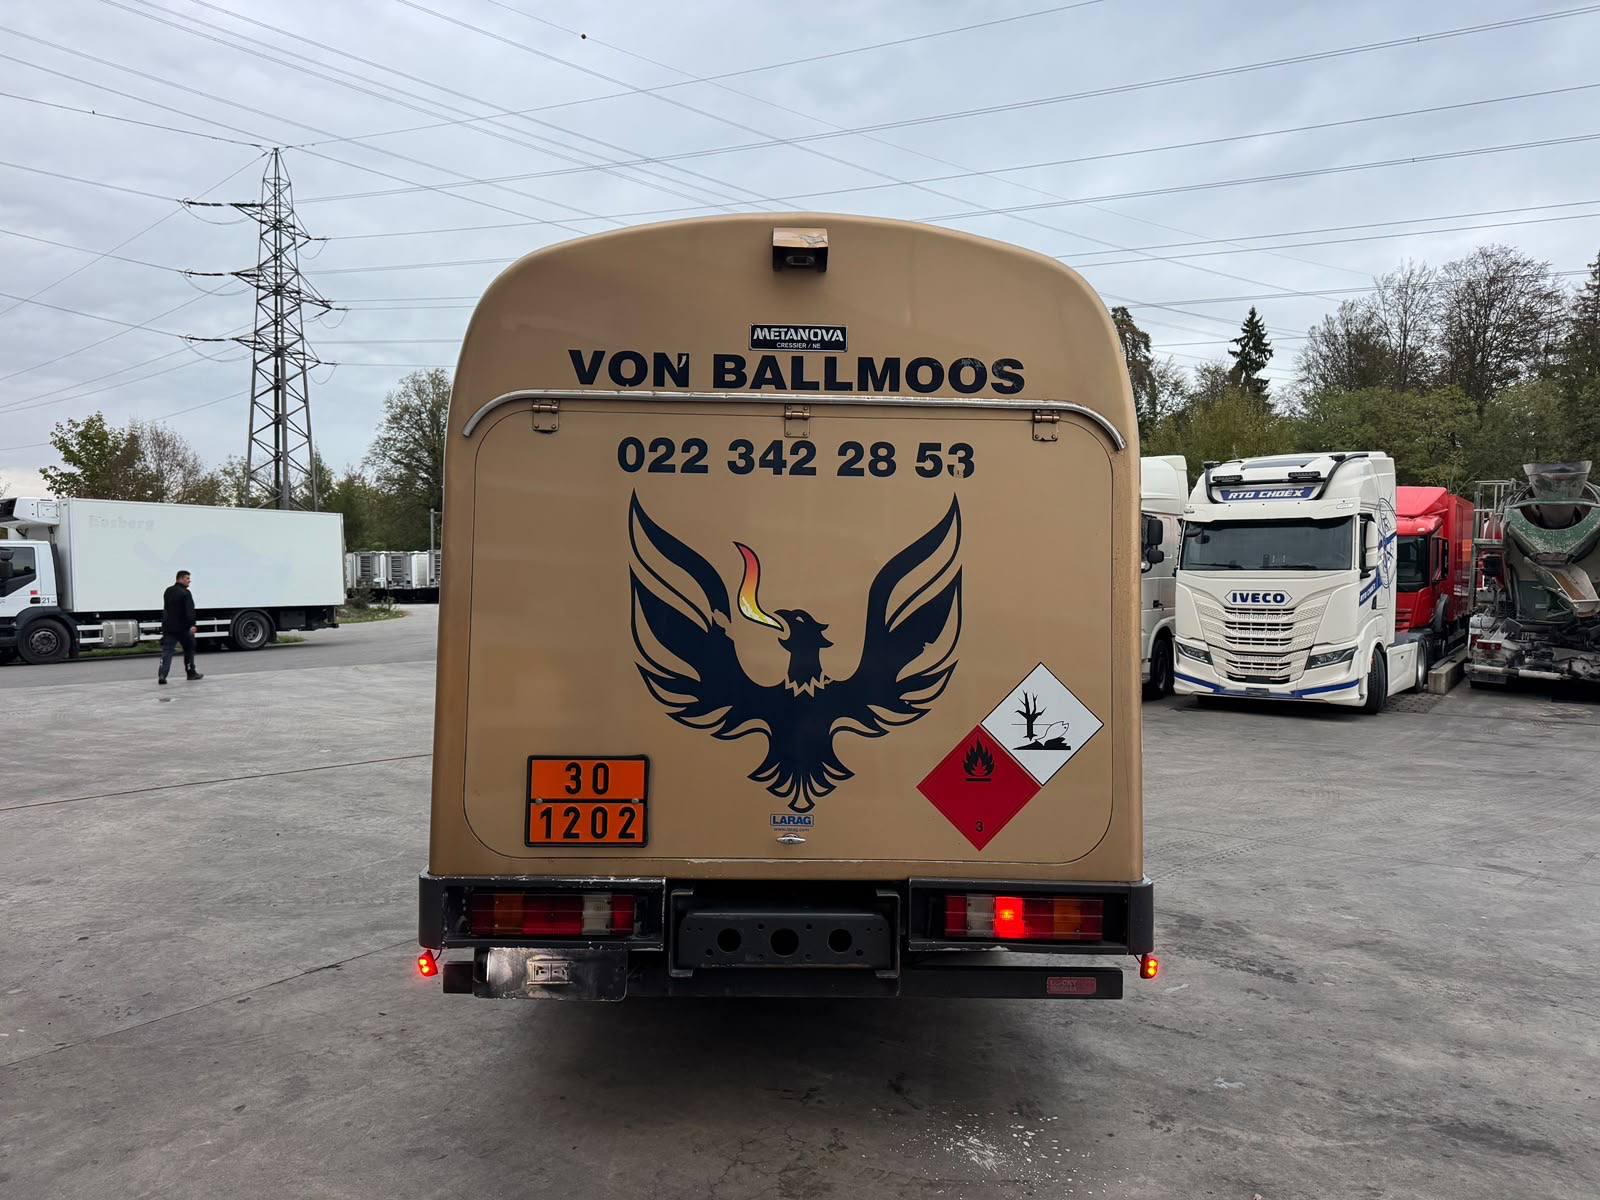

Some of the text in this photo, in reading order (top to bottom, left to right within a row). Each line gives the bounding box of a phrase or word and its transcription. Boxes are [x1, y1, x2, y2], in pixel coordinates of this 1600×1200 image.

[753, 327, 844, 342] METANOVA
[568, 350, 1025, 394] VON BALLMOOS
[617, 437, 975, 479] 022 342 28 53
[1232, 592, 1285, 604] IVECO
[564, 762, 609, 795] 30
[540, 806, 636, 839] 1202
[772, 815, 812, 825] LARAG
[976, 820, 984, 832] 3
